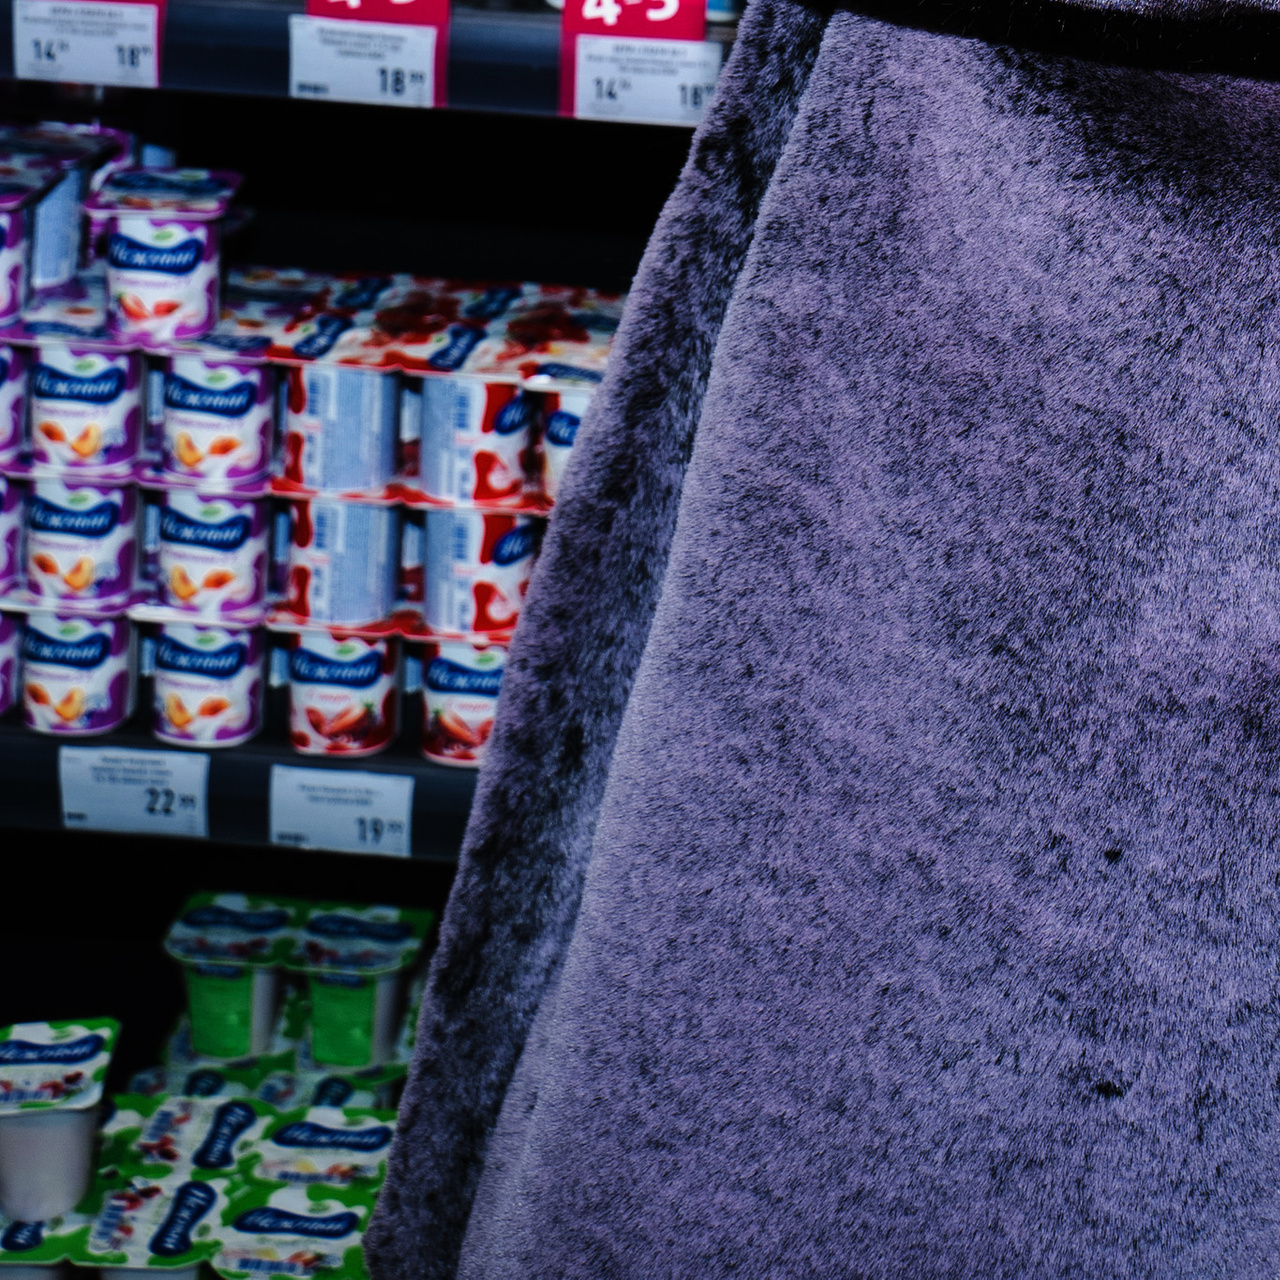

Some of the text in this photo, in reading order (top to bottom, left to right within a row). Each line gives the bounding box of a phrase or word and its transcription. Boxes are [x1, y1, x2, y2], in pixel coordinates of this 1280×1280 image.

[378, 67, 406, 97] 18
[144, 787, 176, 816] 22
[357, 815, 385, 846] 19
